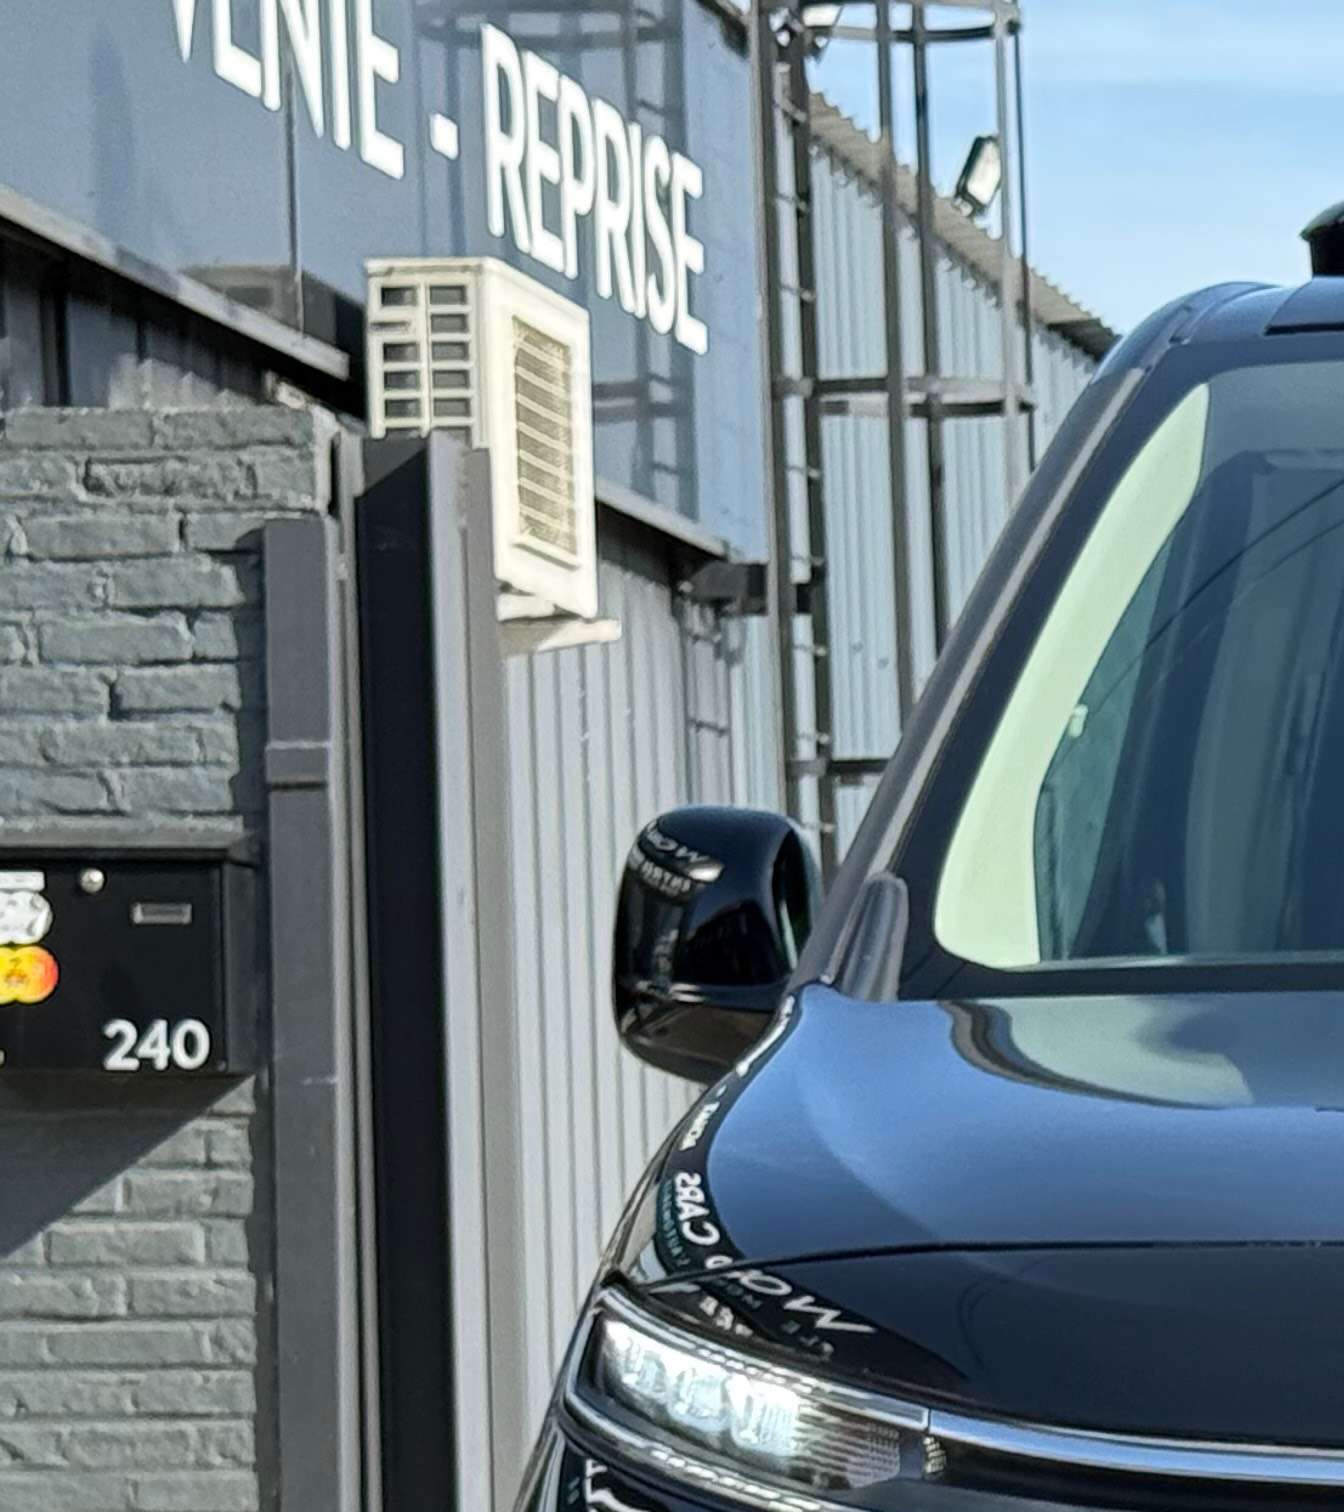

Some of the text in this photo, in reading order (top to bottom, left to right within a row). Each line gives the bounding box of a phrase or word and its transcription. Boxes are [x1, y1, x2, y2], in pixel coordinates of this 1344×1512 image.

[172, 0, 404, 180] NTE
[480, 22, 708, 355] REPRISE
[103, 1018, 210, 1071] 240
